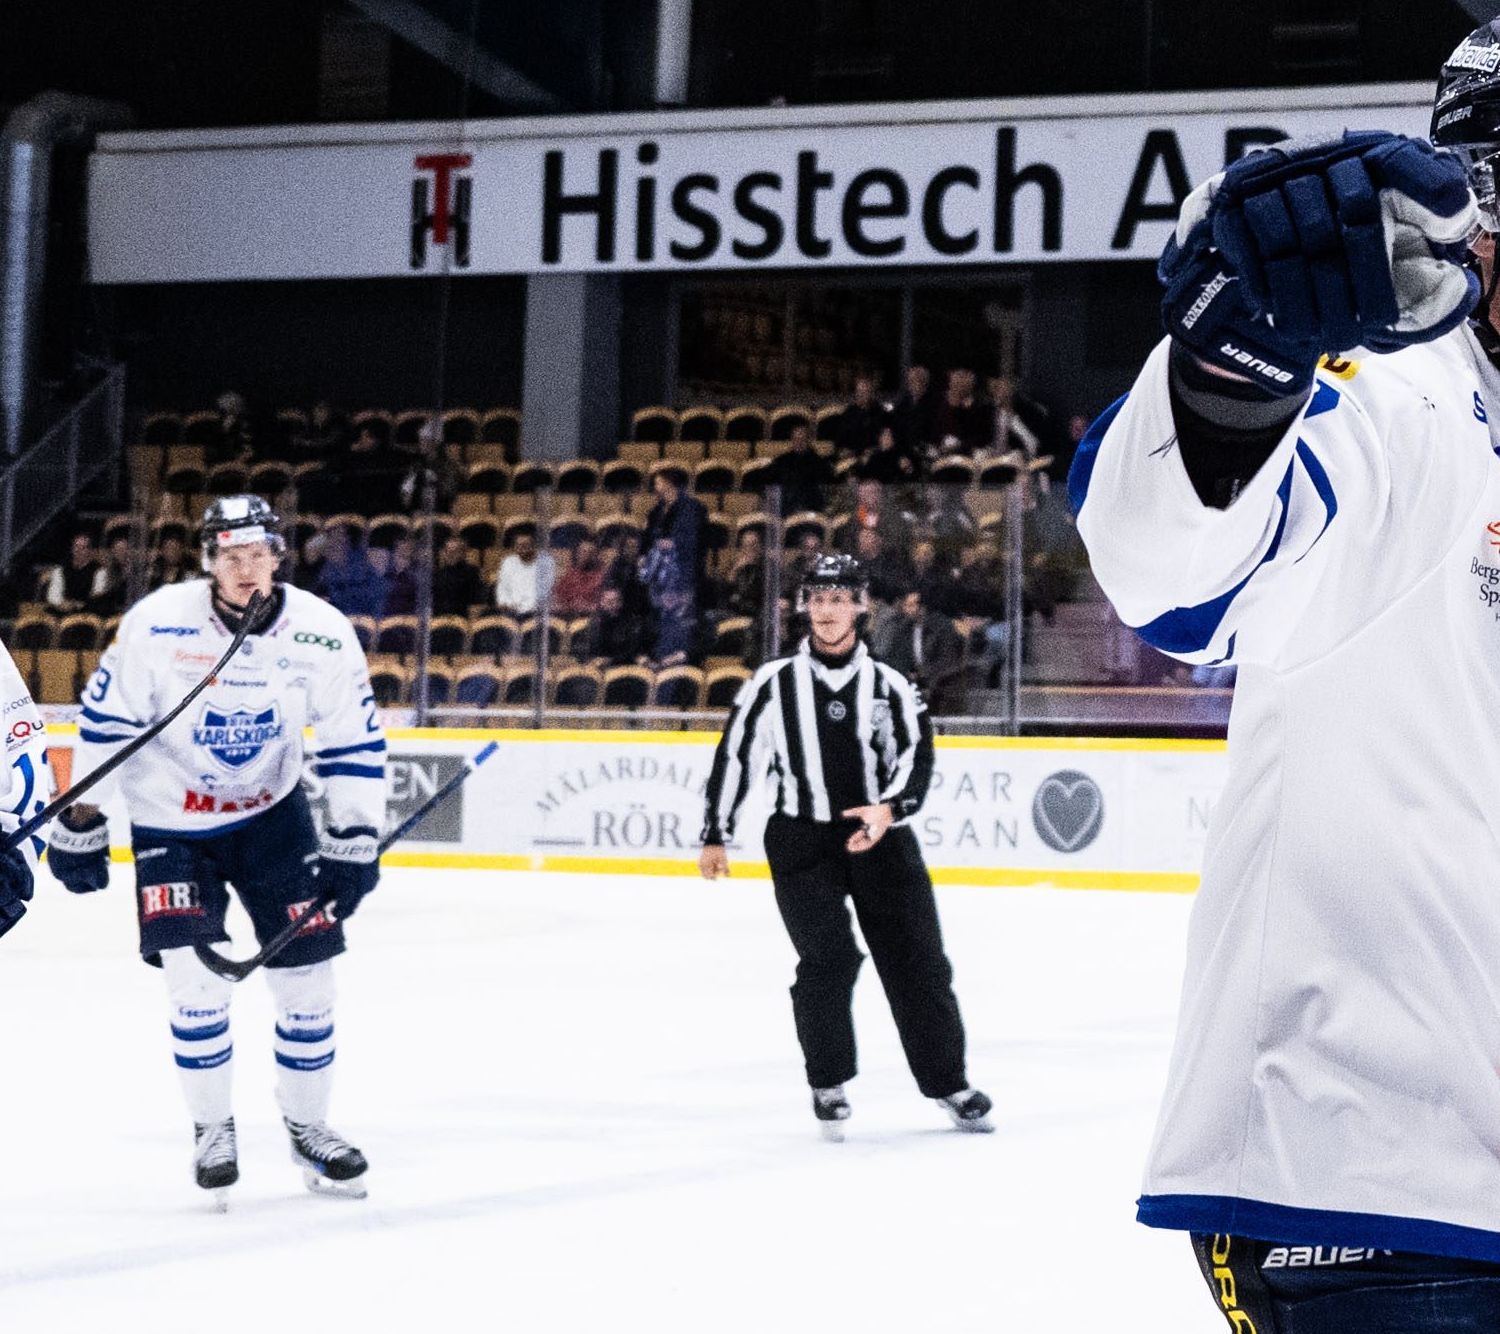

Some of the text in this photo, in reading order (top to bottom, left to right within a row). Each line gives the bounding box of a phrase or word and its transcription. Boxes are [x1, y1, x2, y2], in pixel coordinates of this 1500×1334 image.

[540, 125, 1064, 265] Hisstech
[1220, 343, 1294, 383] BAUER
[294, 631, 342, 651] coop
[591, 803, 683, 849] RÖR
